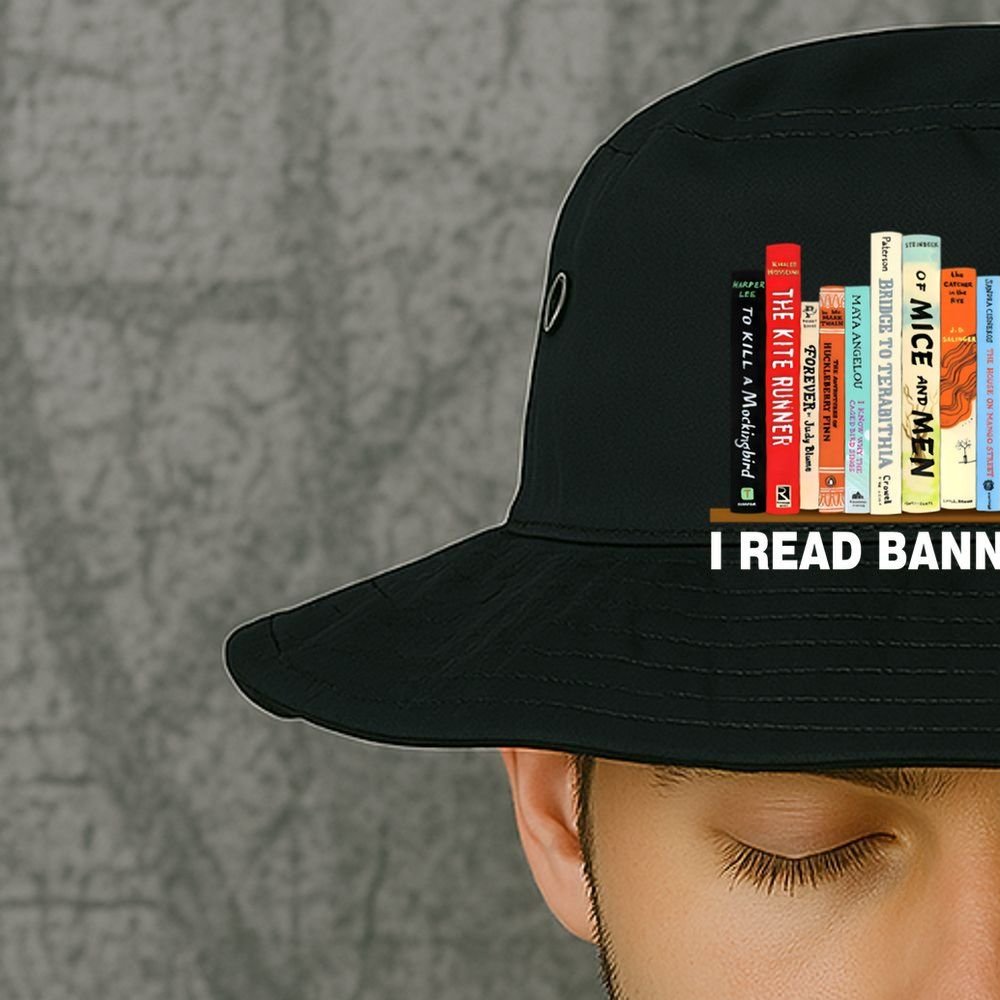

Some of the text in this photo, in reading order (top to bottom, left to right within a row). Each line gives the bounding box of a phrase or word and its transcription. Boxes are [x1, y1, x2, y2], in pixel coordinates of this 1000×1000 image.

[732, 280, 765, 289] HARPER
[882, 236, 891, 272] Paterson
[772, 288, 794, 446] THE KITE RUNNER
[851, 294, 863, 390] MAYA ANGELOU
[877, 278, 894, 469] BRIDGE TO TERABITHIA
[910, 270, 935, 478] OF MICE AND MEN
[734, 306, 758, 479] TO KILL A Mockingbird
[802, 345, 816, 472] FOREVER Judy Blume
[823, 342, 832, 442] HUCKLEBERRY FINN
[986, 397, 994, 410] ON
[986, 412, 994, 445] MANGO
[986, 445, 994, 478] STREET
[710, 530, 722, 570] I
[740, 530, 861, 570] READ
